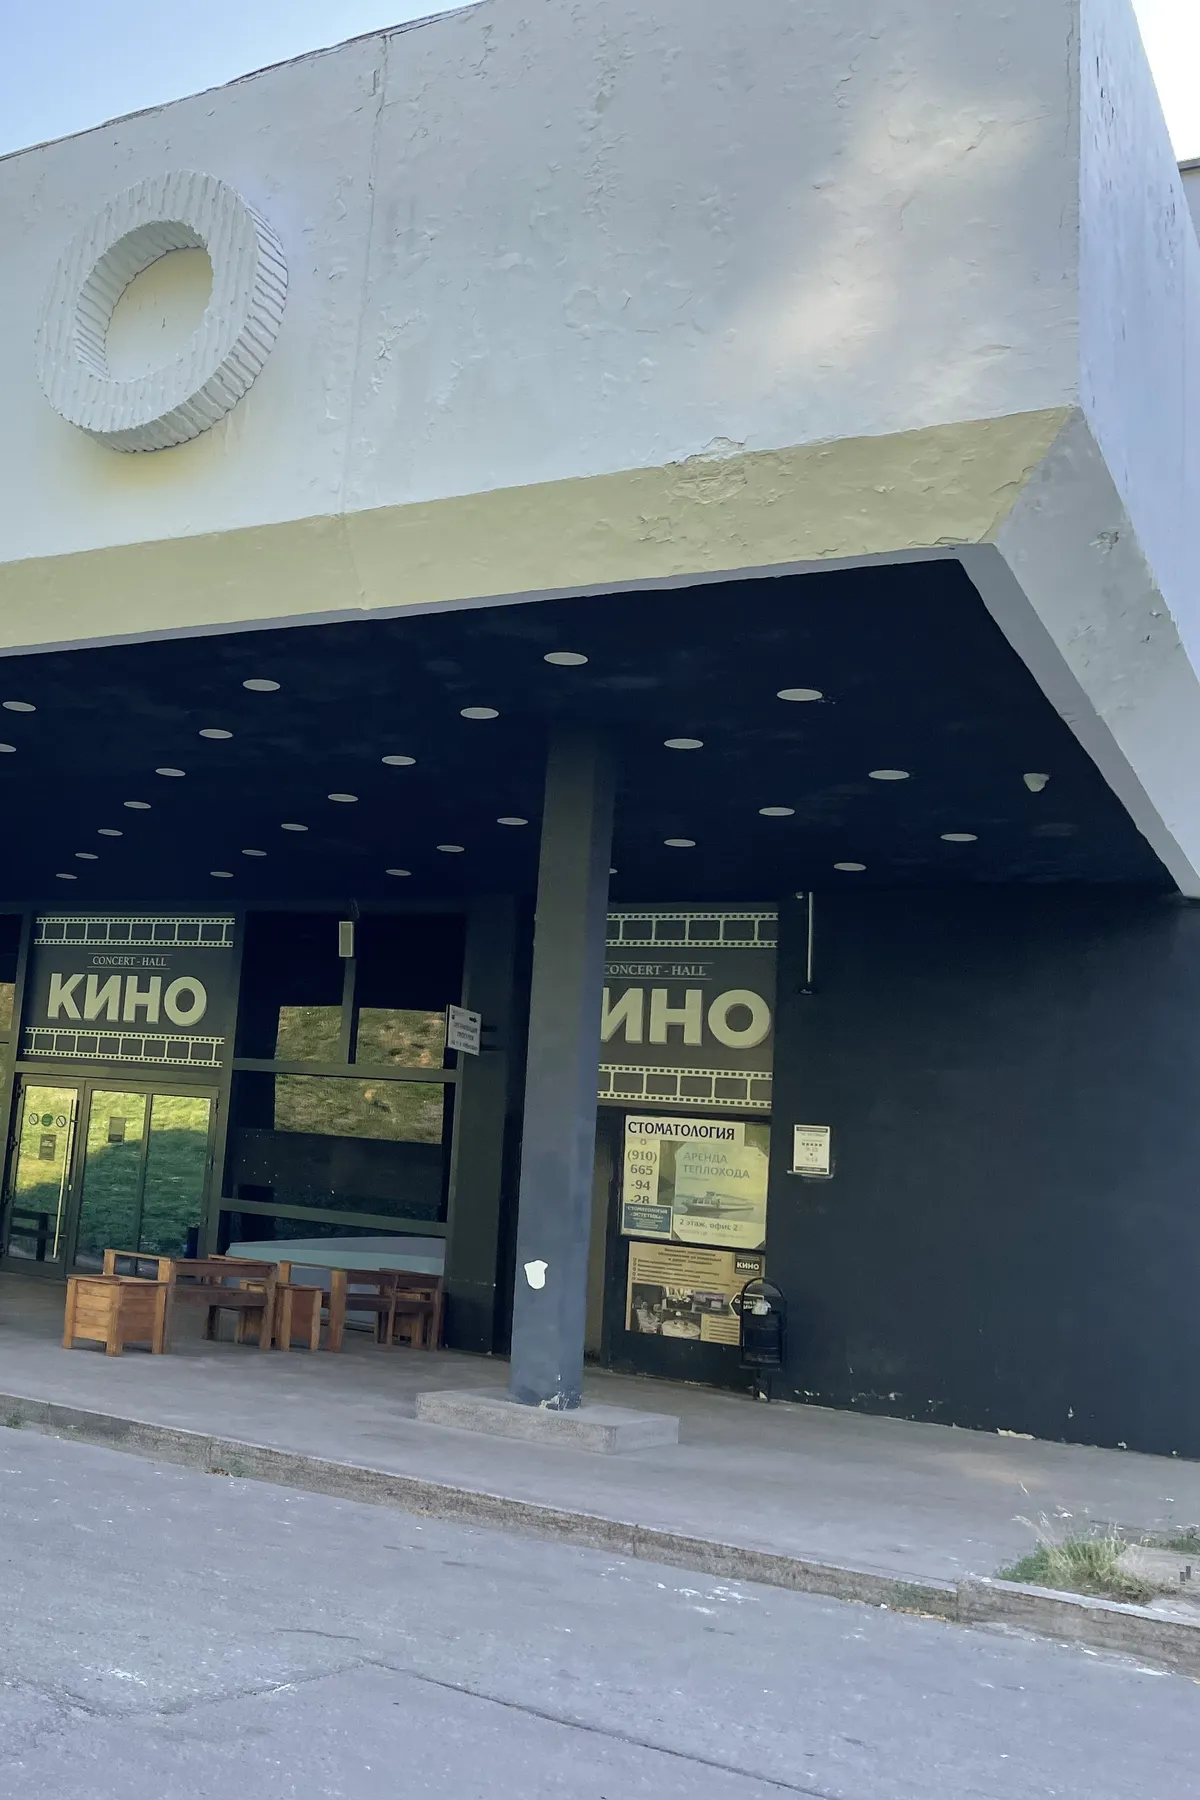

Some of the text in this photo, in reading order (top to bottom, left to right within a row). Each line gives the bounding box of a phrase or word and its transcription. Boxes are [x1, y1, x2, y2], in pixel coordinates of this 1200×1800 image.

[92, 955, 135, 966] CONCERT
[141, 956, 167, 967] HALL
[671, 964, 707, 977] HALL
[47, 972, 208, 1027] КИНО
[600, 986, 772, 1049] ИНО
[628, 1121, 735, 1140] СТОМАТОЛОГИЯ
[627, 1150, 658, 1164] (910)
[683, 1151, 728, 1164] АРЕНДА
[630, 1163, 653, 1175] 665
[683, 1164, 750, 1179] ТЕПЛОХОДА
[630, 1179, 651, 1191] -94
[679, 1218, 685, 1226] 2
[709, 1221, 731, 1232] офис
[736, 1261, 760, 1270] КИНО
